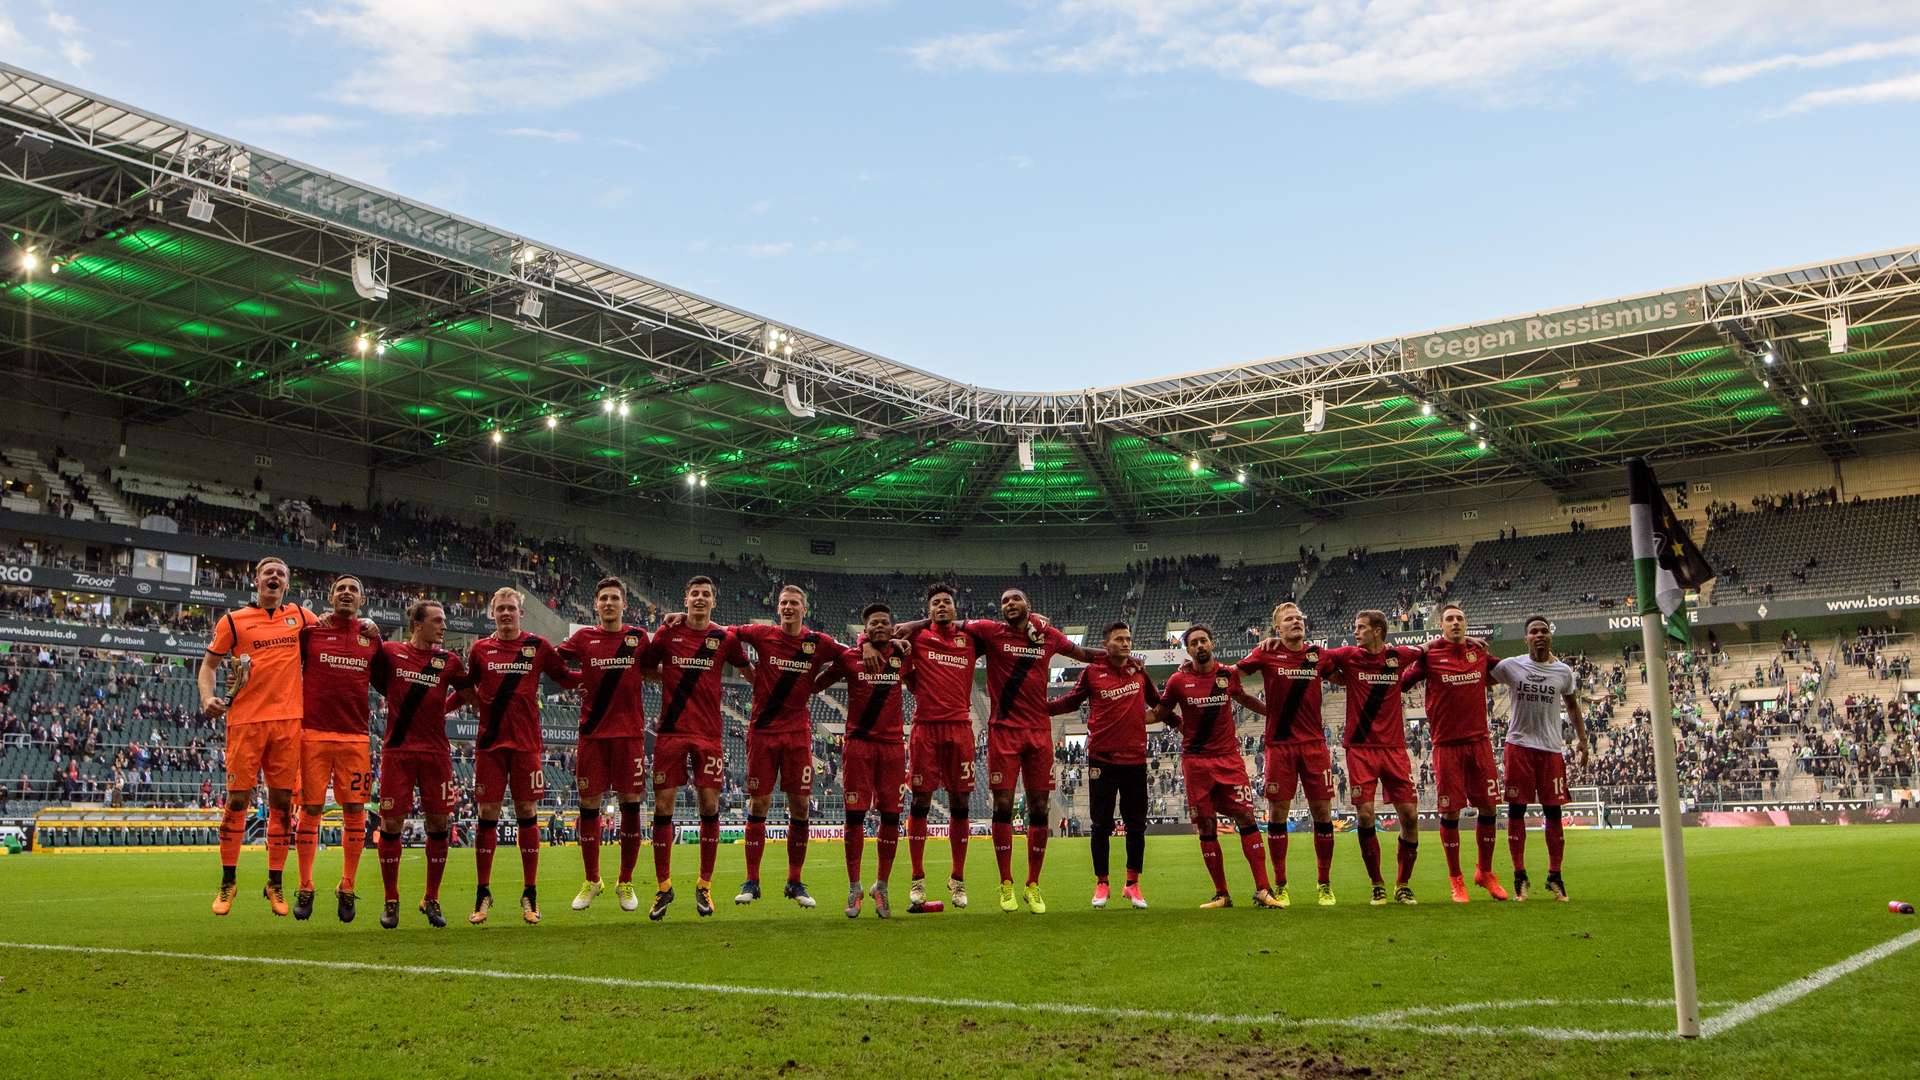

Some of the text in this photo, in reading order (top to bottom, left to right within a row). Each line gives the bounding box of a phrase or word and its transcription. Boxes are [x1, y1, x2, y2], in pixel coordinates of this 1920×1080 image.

[301, 180, 472, 254] Für Borussia
[1423, 300, 1678, 359] Gegen Rassismus
[1571, 505, 1598, 515] Fohlen
[73, 573, 116, 588] Troost
[114, 636, 145, 646] Postbank
[253, 635, 298, 649] Barmenia
[1003, 643, 1045, 655] Barmenia
[320, 653, 368, 668] Barmenia
[590, 655, 635, 667] Barmenia
[671, 655, 714, 667] Barmenia
[769, 656, 812, 670] Barmenia
[928, 651, 968, 666] Barmenia
[487, 661, 533, 671] Barmenia
[1277, 667, 1318, 676] Barmenia
[396, 668, 440, 684] Barmenia
[1358, 672, 1399, 681] Barmenia
[1441, 670, 1481, 683] Barmenia
[1100, 681, 1140, 698] Barmenia
[1517, 681, 1555, 694] JESUS
[1187, 693, 1229, 704] Barmenia
[1527, 694, 1539, 702] DER
[633, 758, 643, 777] 3
[703, 756, 723, 776] 29
[351, 773, 370, 791] 28
[530, 770, 544, 789] 10
[801, 766, 811, 784] 8
[440, 781, 455, 800] 15
[1234, 785, 1252, 802] 38
